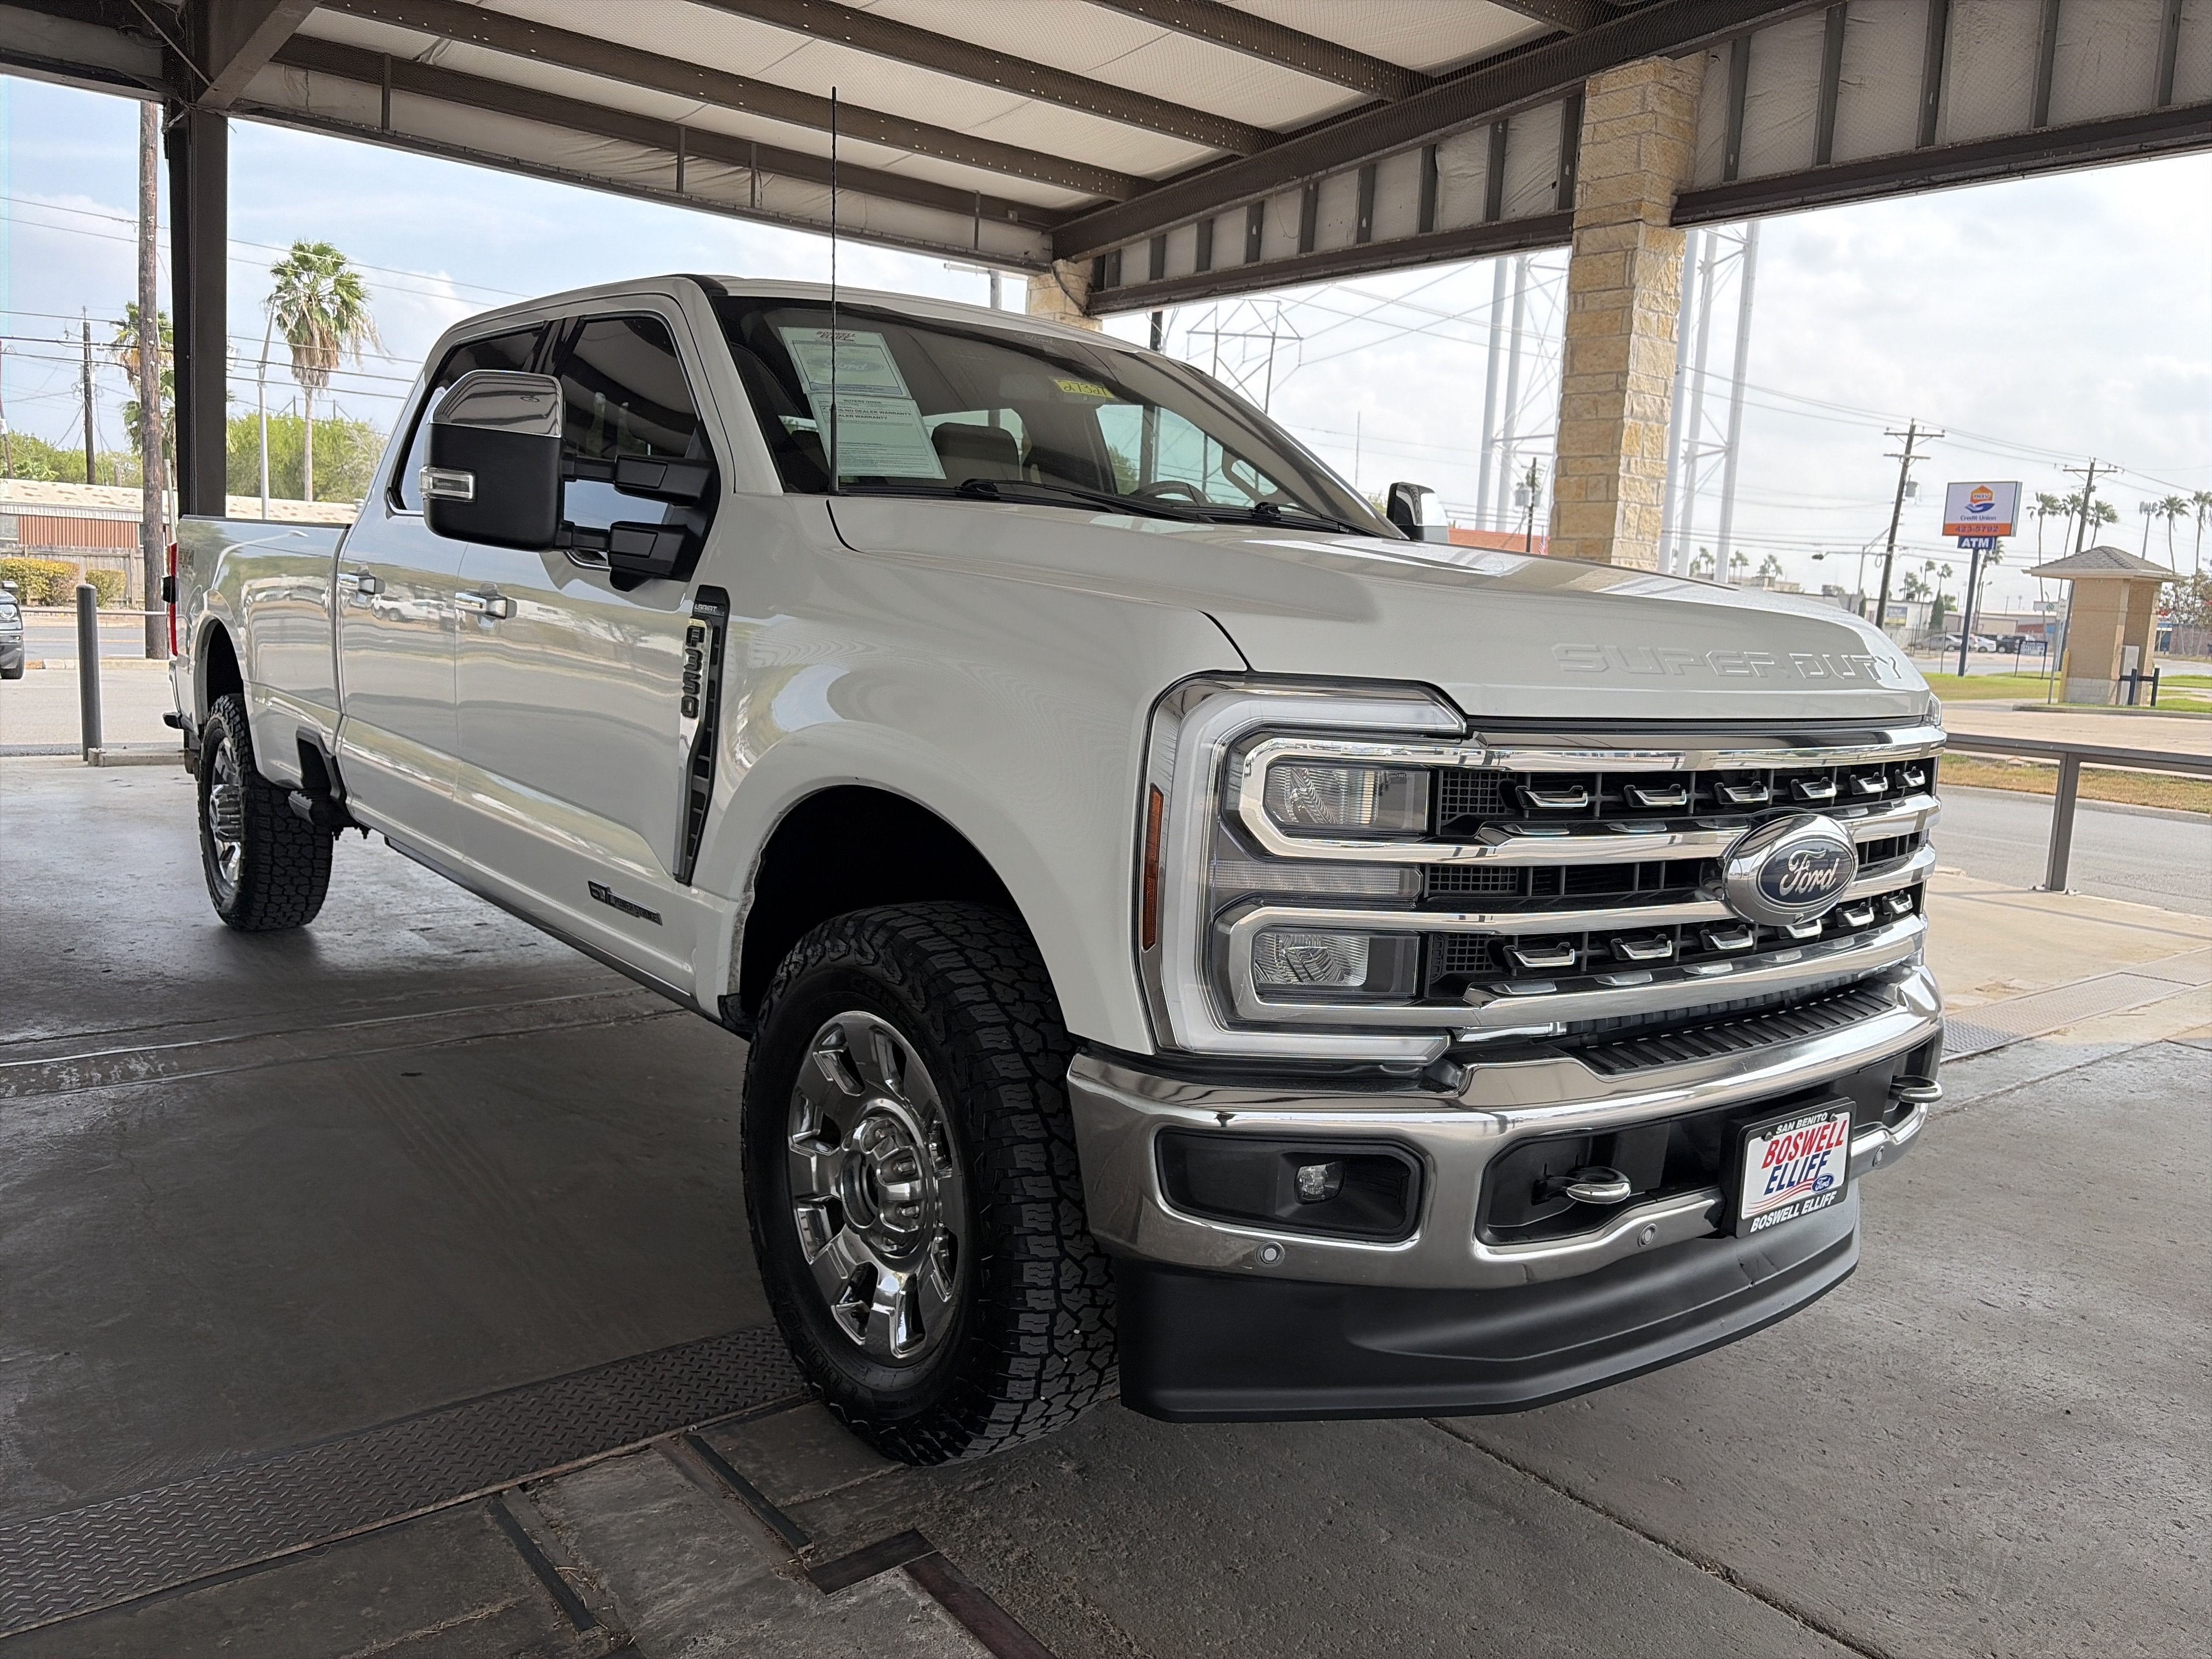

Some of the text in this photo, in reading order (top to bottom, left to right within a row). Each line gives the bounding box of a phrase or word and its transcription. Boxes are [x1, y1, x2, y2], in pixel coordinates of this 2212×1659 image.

[1961, 537, 1989, 548] ATM
[695, 603, 718, 612] LARIAT
[1551, 643, 1901, 680] SUPER DUTY
[1779, 849, 1839, 896] Ford
[1775, 1112, 1828, 1134] SAN BENITO
[1762, 1120, 1848, 1169] BOSWELL
[1763, 1149, 1832, 1195] ELLIFF
[1815, 1178, 1831, 1191] Ford
[1750, 1190, 1837, 1233] BOSWELL ELLIFF
